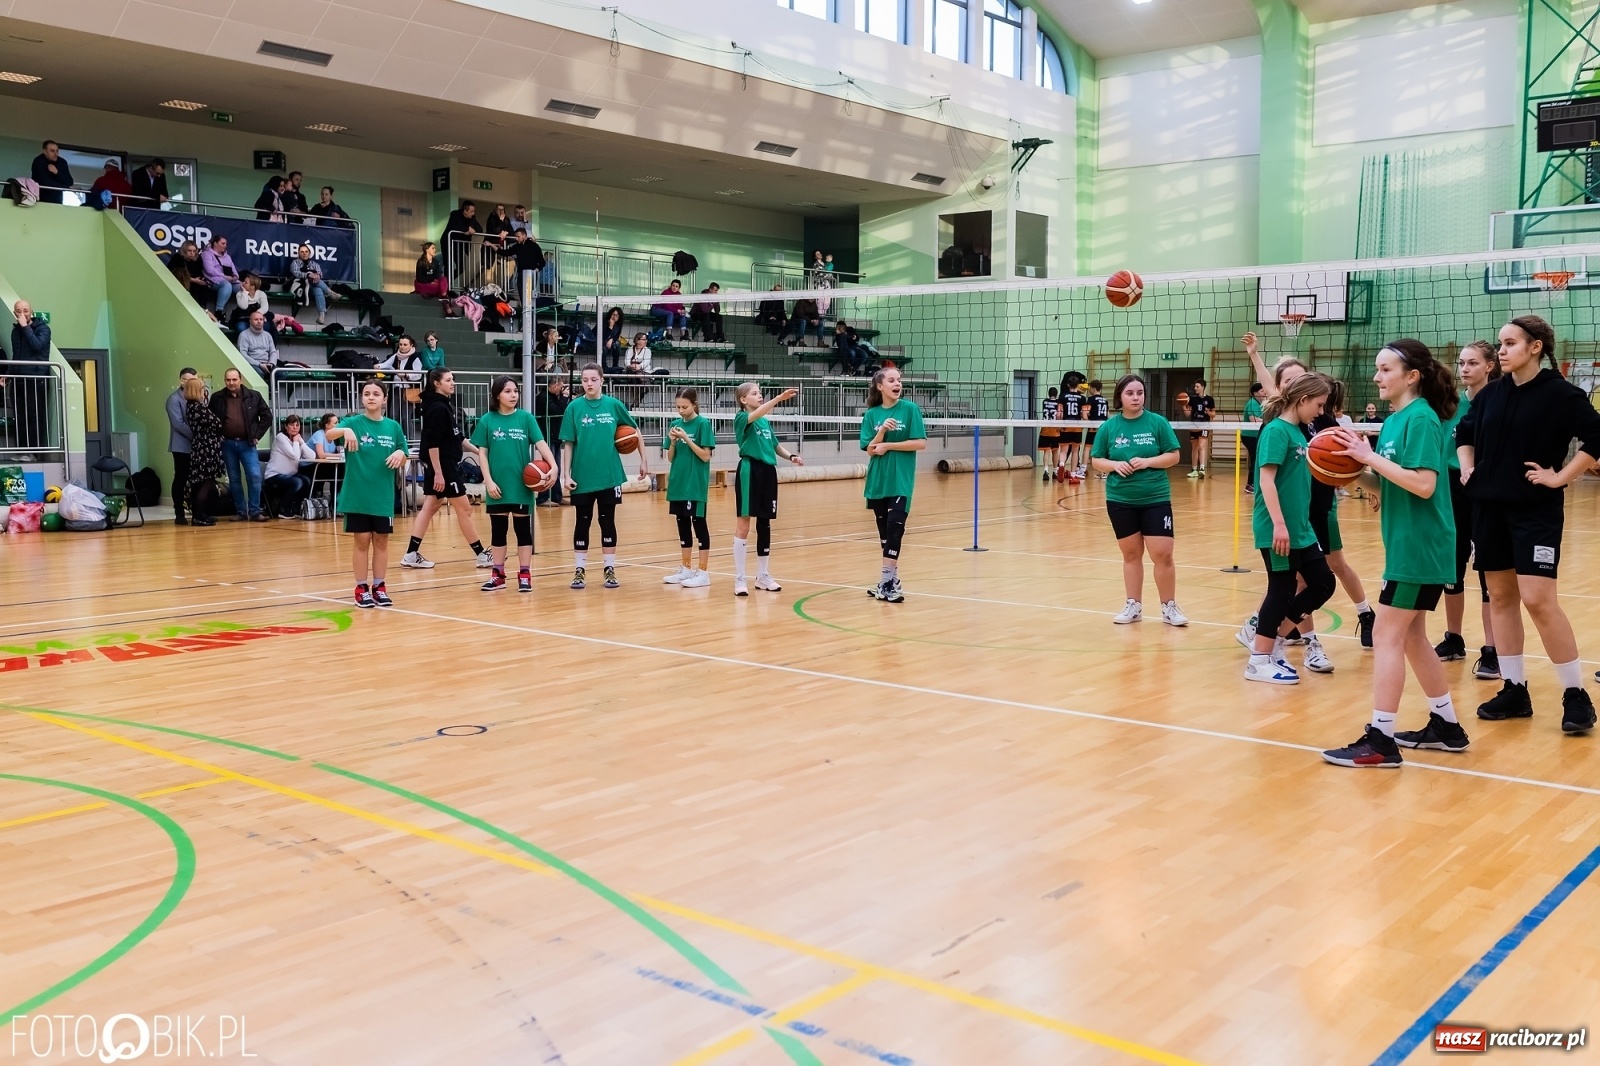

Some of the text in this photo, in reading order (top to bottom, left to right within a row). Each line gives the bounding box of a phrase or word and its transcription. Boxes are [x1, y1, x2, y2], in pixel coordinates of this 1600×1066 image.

[261, 157, 273, 167] F
[437, 175, 446, 188] F
[1066, 402, 1079, 416] 16
[1097, 403, 1108, 417] 14
[449, 482, 459, 494] 7
[1163, 515, 1171, 530] 14
